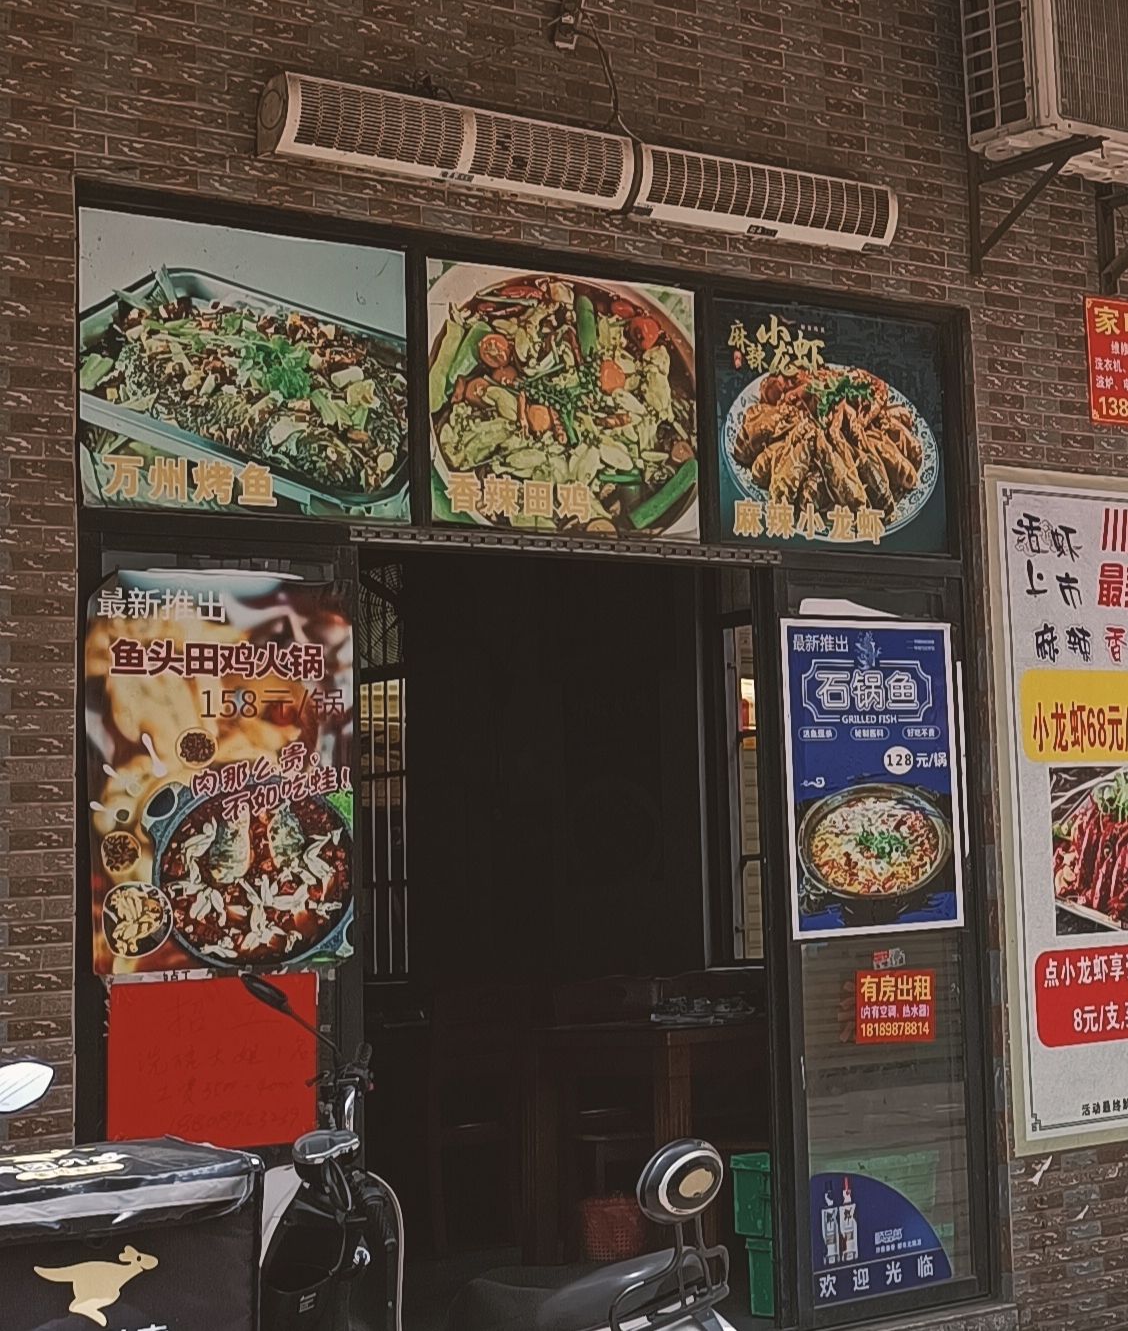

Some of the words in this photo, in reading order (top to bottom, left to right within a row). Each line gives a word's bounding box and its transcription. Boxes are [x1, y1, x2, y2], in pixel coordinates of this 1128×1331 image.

[103, 455, 278, 507] 万州烤鱼
[446, 472, 593, 522] 香辣田鸡
[732, 499, 885, 543] 麻辣小龙虾
[97, 587, 226, 622] 最新推出
[109, 637, 325, 681] 鱼头田鸡火锅
[793, 633, 849, 653] 最新推出
[200, 687, 345, 720] 158元/锅
[815, 669, 919, 712] 石锅鱼
[842, 714, 876, 725] GRILLED
[878, 714, 898, 725] FISH
[886, 753, 912, 767] 128
[916, 752, 948, 768] 元/锅
[860, 974, 932, 1003] 有房出租
[819, 1255, 935, 1299] 欢迎光临
